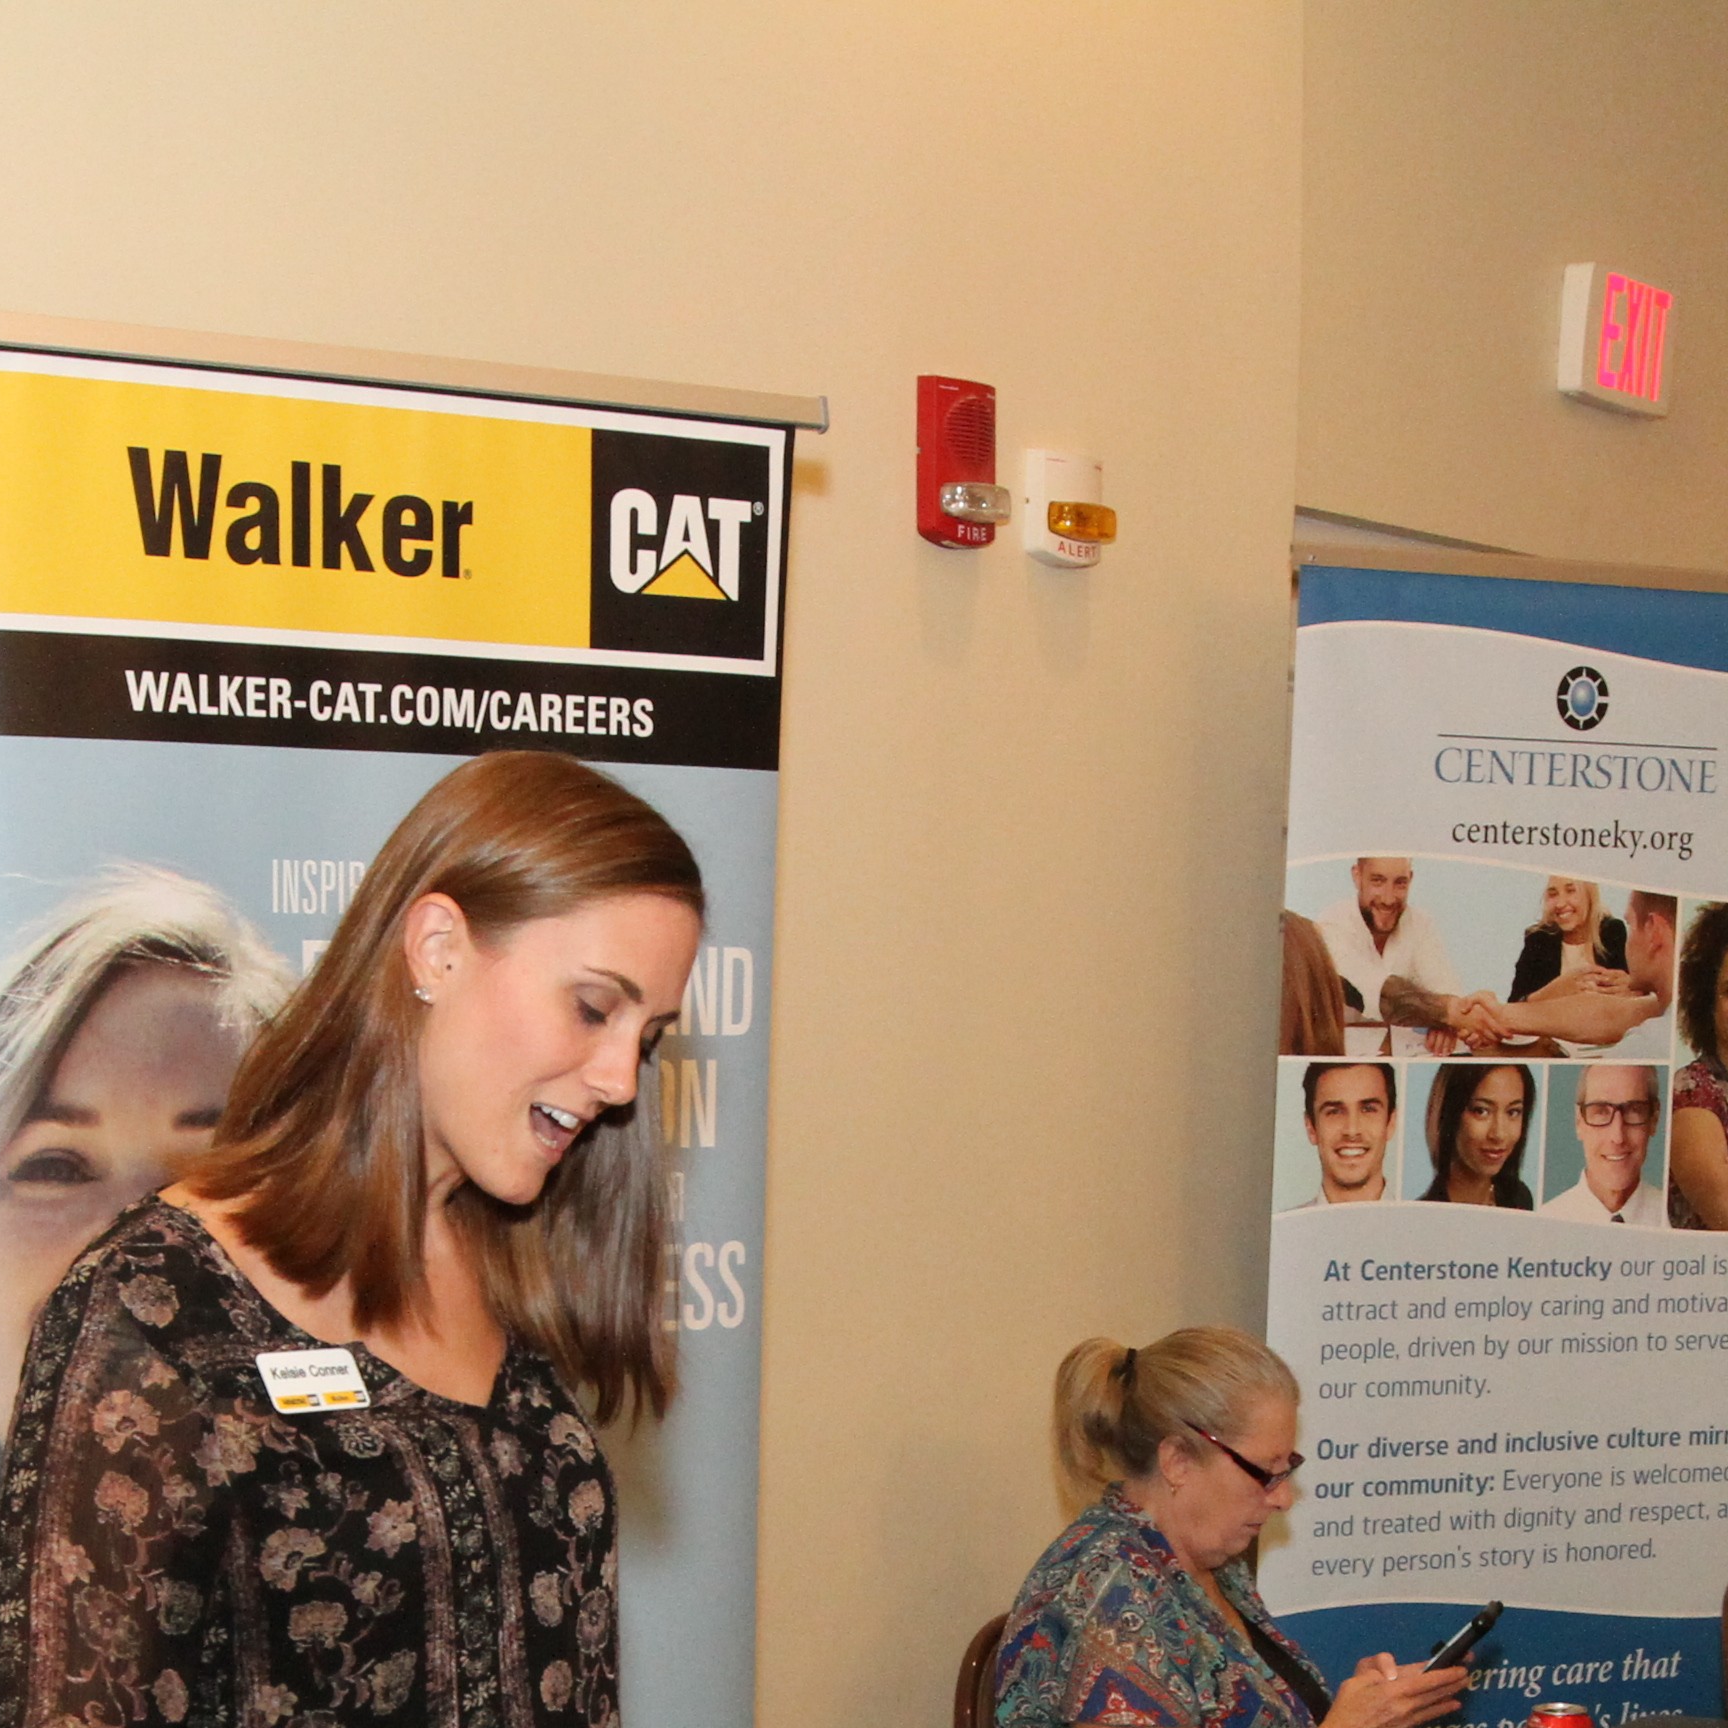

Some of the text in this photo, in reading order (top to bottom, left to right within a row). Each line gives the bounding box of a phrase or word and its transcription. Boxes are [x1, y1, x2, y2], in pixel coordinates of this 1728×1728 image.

[1597, 272, 1673, 402] EXIT
[127, 446, 472, 579] Walker
[610, 487, 752, 601] CAT
[957, 524, 987, 541] FIRE
[1058, 540, 1097, 559] ALERT
[125, 670, 655, 738] WALKER-CAT.COM/CAREERS
[1434, 746, 1717, 794] CENTERSTONE
[1452, 819, 1694, 860] centerstoneky.org
[1323, 1259, 1351, 1282] At
[1360, 1258, 1499, 1282] Centerstone
[1507, 1256, 1613, 1281] Kentucky
[1620, 1257, 1655, 1278] our
[1662, 1255, 1706, 1280] goal
[1713, 1255, 1728, 1277] is
[1321, 1300, 1398, 1322] attract
[1407, 1299, 1446, 1321] and
[1454, 1296, 1532, 1322] employ
[1540, 1296, 1605, 1320] caring
[1611, 1294, 1651, 1316] and
[1320, 1336, 1401, 1365] people,
[1408, 1334, 1475, 1360] driven
[1483, 1333, 1510, 1360] by
[1517, 1336, 1554, 1356] our
[1561, 1331, 1639, 1355] mission
[1646, 1332, 1667, 1353] to
[1318, 1374, 1491, 1400] our community.
[1317, 1438, 1360, 1462] Our
[1367, 1435, 1449, 1460] diverse
[1456, 1433, 1498, 1456] and
[1504, 1429, 1599, 1454] inclusive
[1606, 1426, 1681, 1450] culture
[1314, 1479, 1351, 1500] our
[1362, 1471, 1496, 1500] community:
[1502, 1467, 1603, 1496] Everyone
[1610, 1465, 1626, 1488] is
[1313, 1514, 1354, 1539] and
[1362, 1511, 1441, 1536] treated
[1449, 1509, 1496, 1532] with
[1503, 1505, 1576, 1534] dignity
[1584, 1503, 1621, 1526] and
[1629, 1500, 1710, 1528] respect,
[1311, 1538, 1657, 1578] every person's story is honored.
[1552, 1661, 1613, 1686] care
[1622, 1649, 1682, 1680] that
